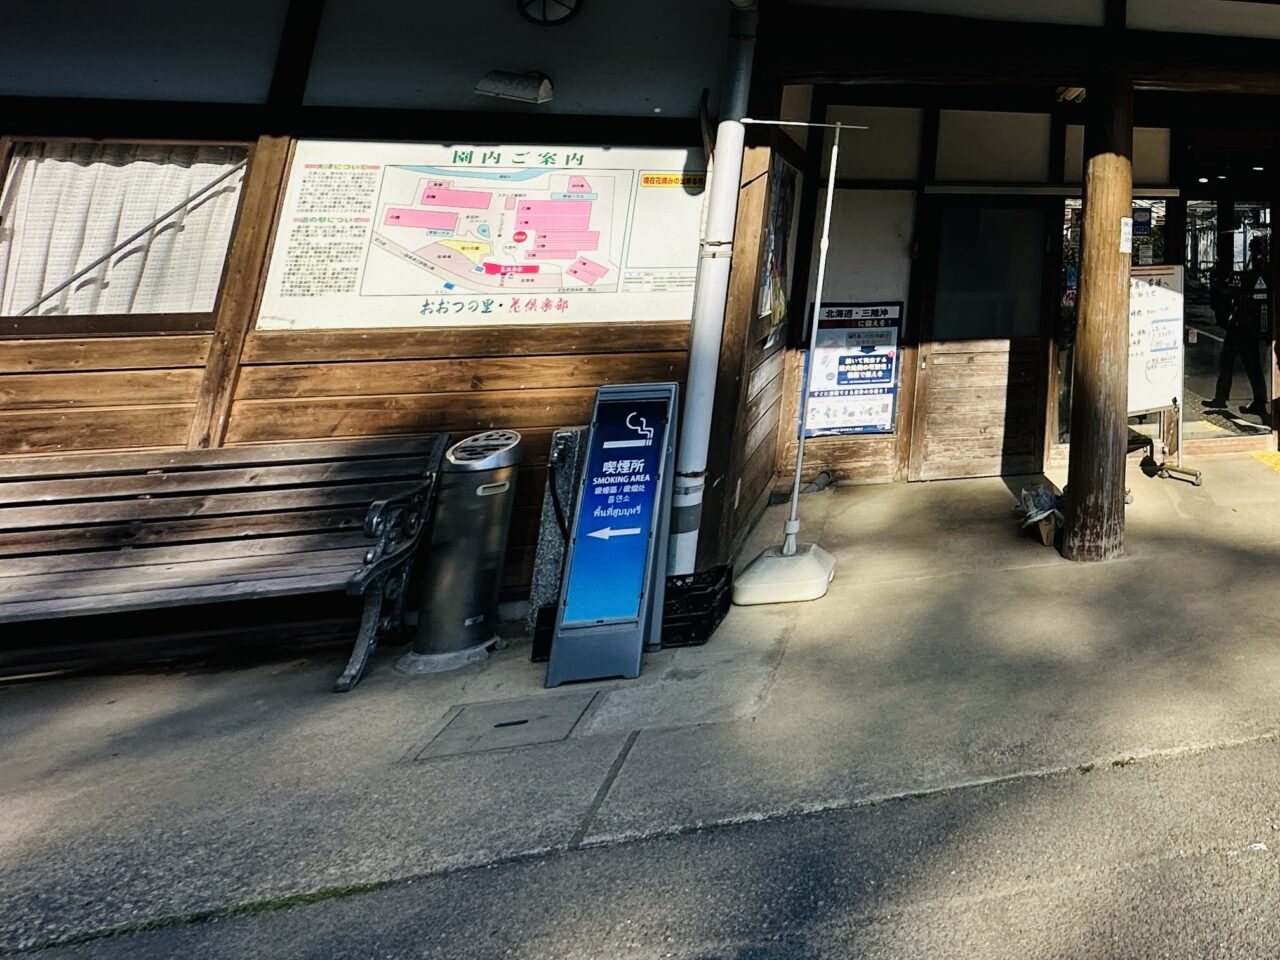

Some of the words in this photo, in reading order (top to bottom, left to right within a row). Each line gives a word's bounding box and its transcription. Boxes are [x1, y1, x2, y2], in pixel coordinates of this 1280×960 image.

[452, 150, 585, 166] 園内ご案内
[602, 459, 645, 474] 喫煙所
[592, 475, 629, 485] SMOKING
[630, 474, 650, 482] AREA
